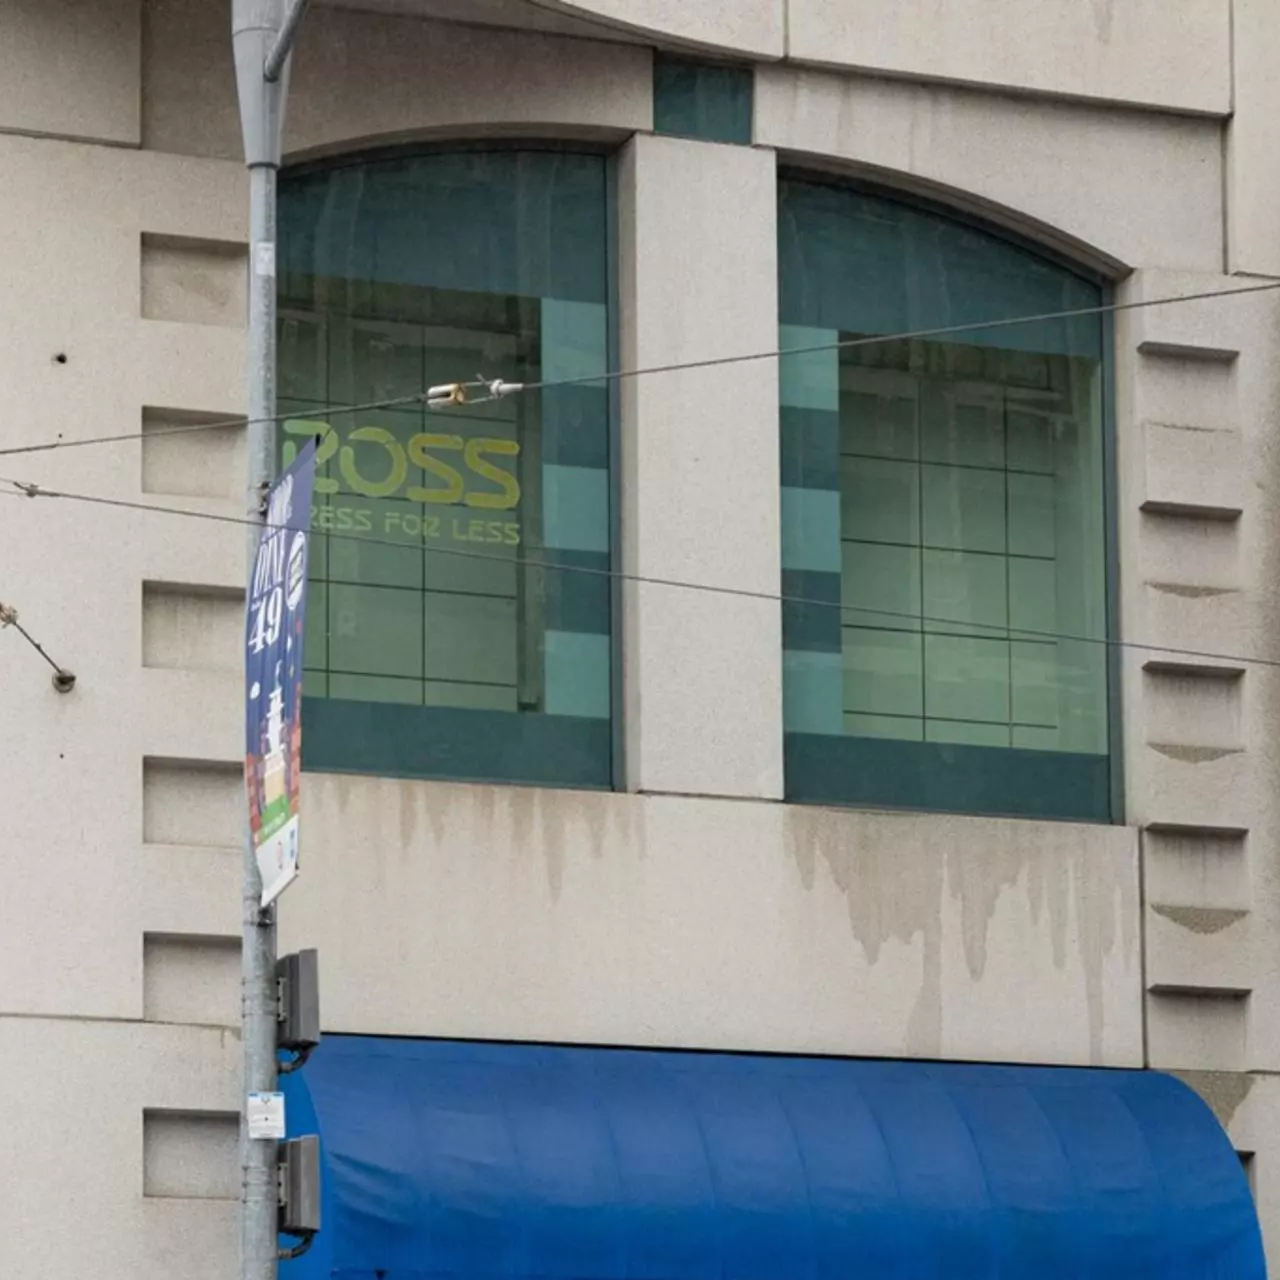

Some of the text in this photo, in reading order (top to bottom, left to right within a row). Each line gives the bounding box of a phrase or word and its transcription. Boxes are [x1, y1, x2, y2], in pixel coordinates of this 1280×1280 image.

[283, 419, 520, 509] ROSS
[309, 506, 521, 545] RESS FOR LESS
